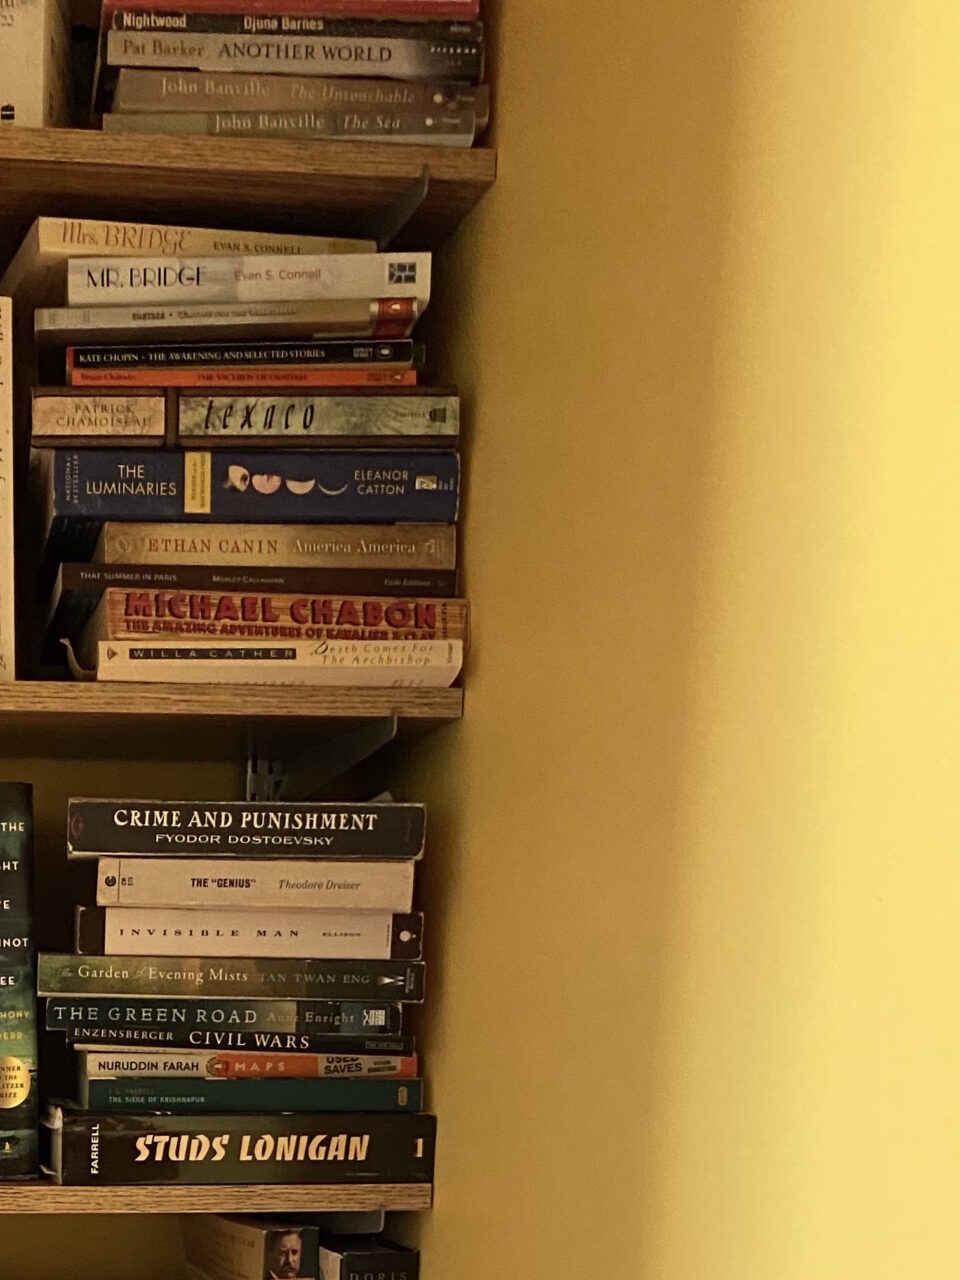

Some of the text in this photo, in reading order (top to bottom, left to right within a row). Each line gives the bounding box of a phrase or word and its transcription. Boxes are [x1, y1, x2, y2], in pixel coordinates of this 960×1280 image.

[122, 13, 324, 31] Nightwood Djuna Barnes
[219, 43, 392, 63] ANOTHER WORLD
[118, 464, 144, 479] THE
[354, 470, 409, 481] ELEANOR
[86, 480, 177, 496] LUMINARIES
[357, 483, 404, 495] CATTON
[125, 592, 437, 630] MICHAEL CHABON
[2, 822, 25, 832] THE
[114, 810, 378, 831] CRIME AND PUNISHMENT
[155, 834, 334, 846] FYODOR DOSTOEVSKY
[119, 929, 300, 937] INVISIBLE MAN
[54, 1007, 257, 1023] THE GREEN ROAD
[189, 1031, 310, 1049] CIVIL WARS
[98, 1060, 199, 1071] NURUDDIN FARAH
[90, 1123, 100, 1174] FARRELL
[135, 1134, 423, 1162] STUDS LONIGAN 1
